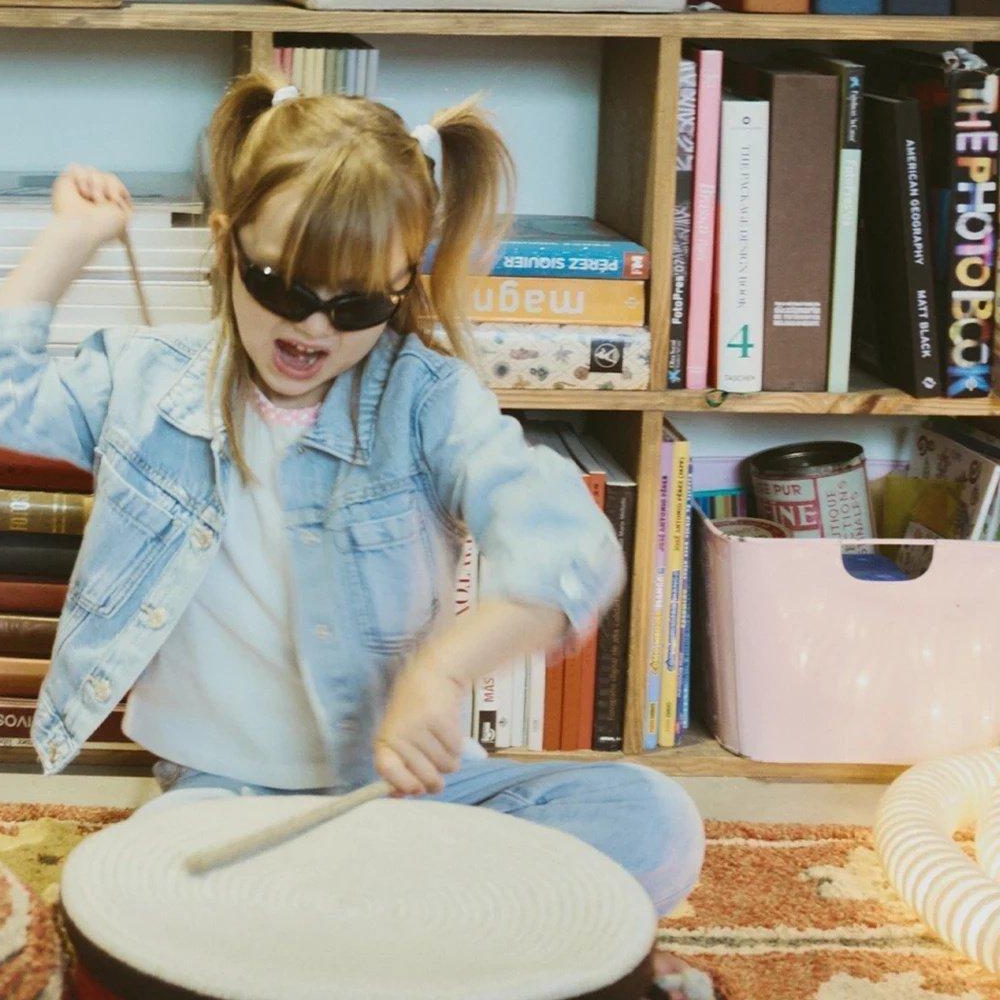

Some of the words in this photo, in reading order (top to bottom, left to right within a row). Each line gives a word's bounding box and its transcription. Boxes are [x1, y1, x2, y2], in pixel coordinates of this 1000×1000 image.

[741, 144, 751, 171] THE
[905, 138, 919, 197] AMERICAN
[740, 173, 750, 225] PACKAGE
[911, 199, 926, 266] GEOGRAPHY
[568, 256, 620, 274] PÉREZ
[738, 229, 748, 274] DESIGN
[471, 280, 585, 315] magn
[737, 276, 747, 310] BOOK
[916, 290, 927, 320] MATT
[726, 324, 754, 359] 4
[919, 322, 932, 358] BLACK
[773, 484, 802, 496] PUR
